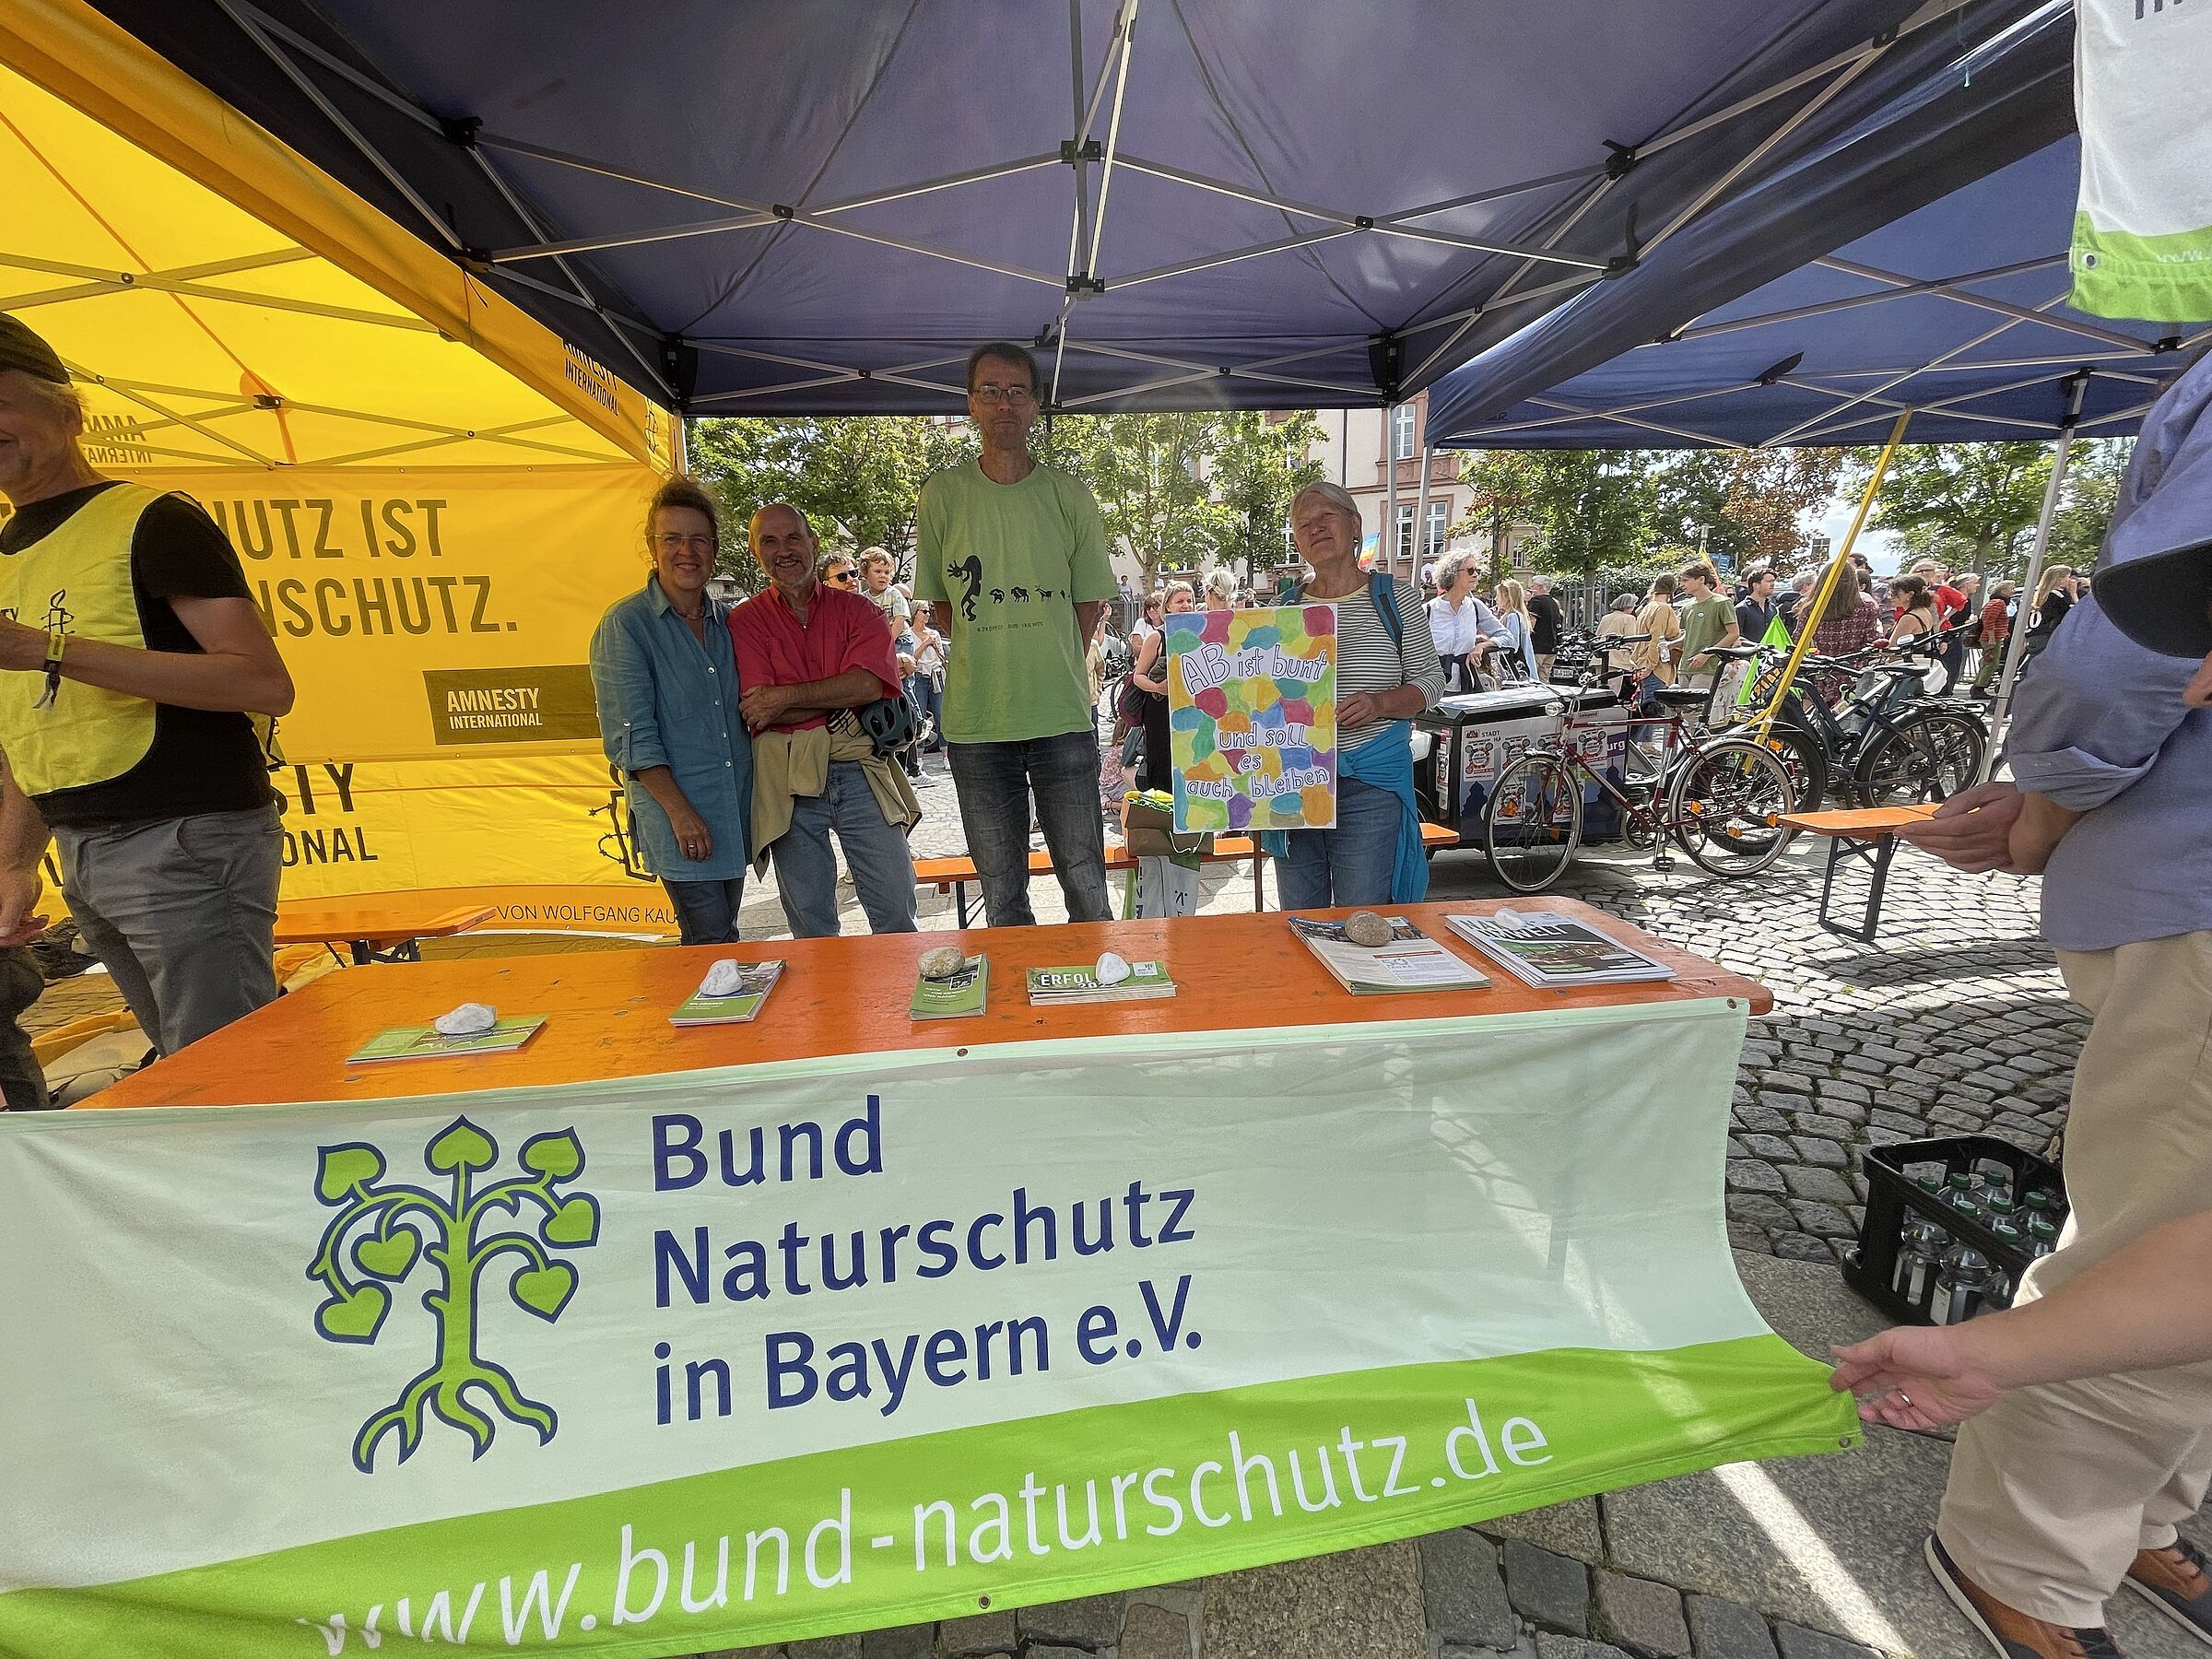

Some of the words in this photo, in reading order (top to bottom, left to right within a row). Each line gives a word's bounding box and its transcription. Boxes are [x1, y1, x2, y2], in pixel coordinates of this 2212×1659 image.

[565, 357, 618, 418] INTERNATIONAL
[360, 499, 448, 559] IST
[1182, 642, 1230, 694] AB
[1238, 649, 1264, 677] ist
[1272, 644, 1327, 681] bunt
[447, 688, 539, 712] AMNESTY
[450, 712, 543, 730] INTERNATIONAL
[1218, 723, 1257, 748] und
[1265, 725, 1309, 747] soll
[1481, 730, 1500, 738] STADT
[1241, 753, 1262, 771] es
[1186, 779, 1233, 798] auch
[1251, 767, 1329, 798] bleiben
[497, 905, 537, 920] VON
[543, 905, 640, 923] WOLFGANG
[652, 1094, 883, 1193] Bund
[653, 1180, 1196, 1308] Naturschutz
[653, 1341, 732, 1426] in
[765, 1313, 1049, 1418] Bayern
[1076, 1275, 1202, 1366] e.V.
